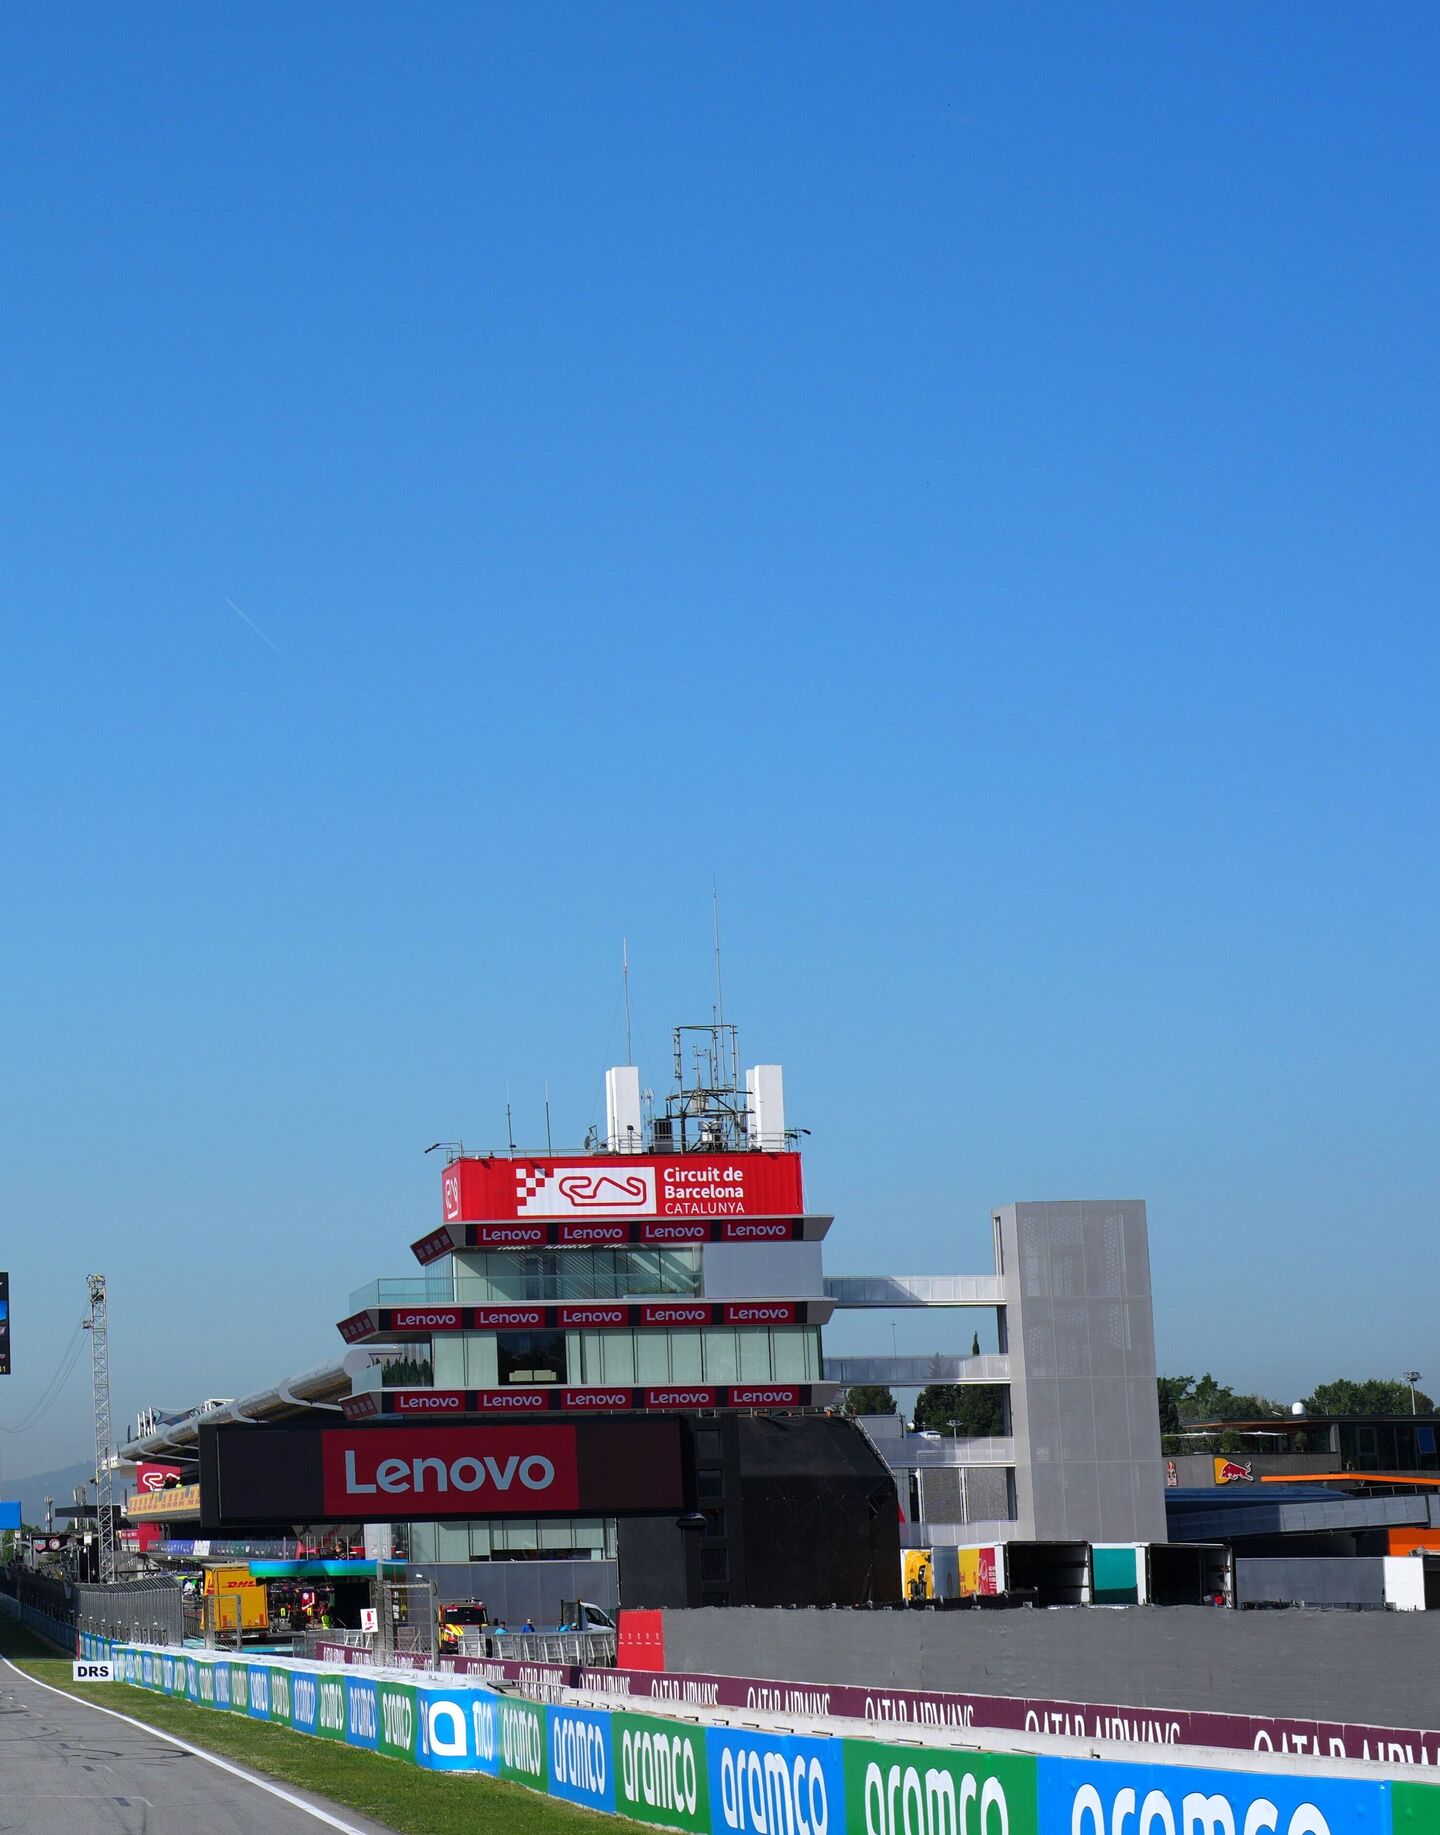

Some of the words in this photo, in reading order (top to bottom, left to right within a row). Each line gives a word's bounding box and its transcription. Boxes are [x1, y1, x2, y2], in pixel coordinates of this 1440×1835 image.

[664, 1167, 720, 1182] Circuit
[723, 1167, 743, 1181] de
[664, 1184, 744, 1199] Barcelona
[665, 1202, 745, 1214] CATALUNYA
[483, 1228, 542, 1241] Lenovo
[564, 1226, 623, 1239] Lenovo
[645, 1225, 705, 1238] Lenovo
[727, 1223, 786, 1236] Lenovo
[397, 1313, 456, 1326] Lenovo
[480, 1311, 539, 1324] Lenovo
[563, 1310, 623, 1323] Lenovo
[646, 1308, 706, 1321] Lenovo
[729, 1307, 789, 1320] Lenovo
[400, 1395, 459, 1408] Lenovo
[483, 1394, 543, 1407] Lenovo
[566, 1392, 626, 1406] Lenovo
[650, 1391, 710, 1404] Lenovo
[733, 1390, 793, 1403] Lenovo
[344, 1449, 555, 1494] Lenovo
[77, 1666, 109, 1677] DRS
[503, 1707, 541, 1777] aramco
[553, 1716, 605, 1795] aramco
[622, 1729, 696, 1815] aramco
[721, 1747, 828, 1835] aramco
